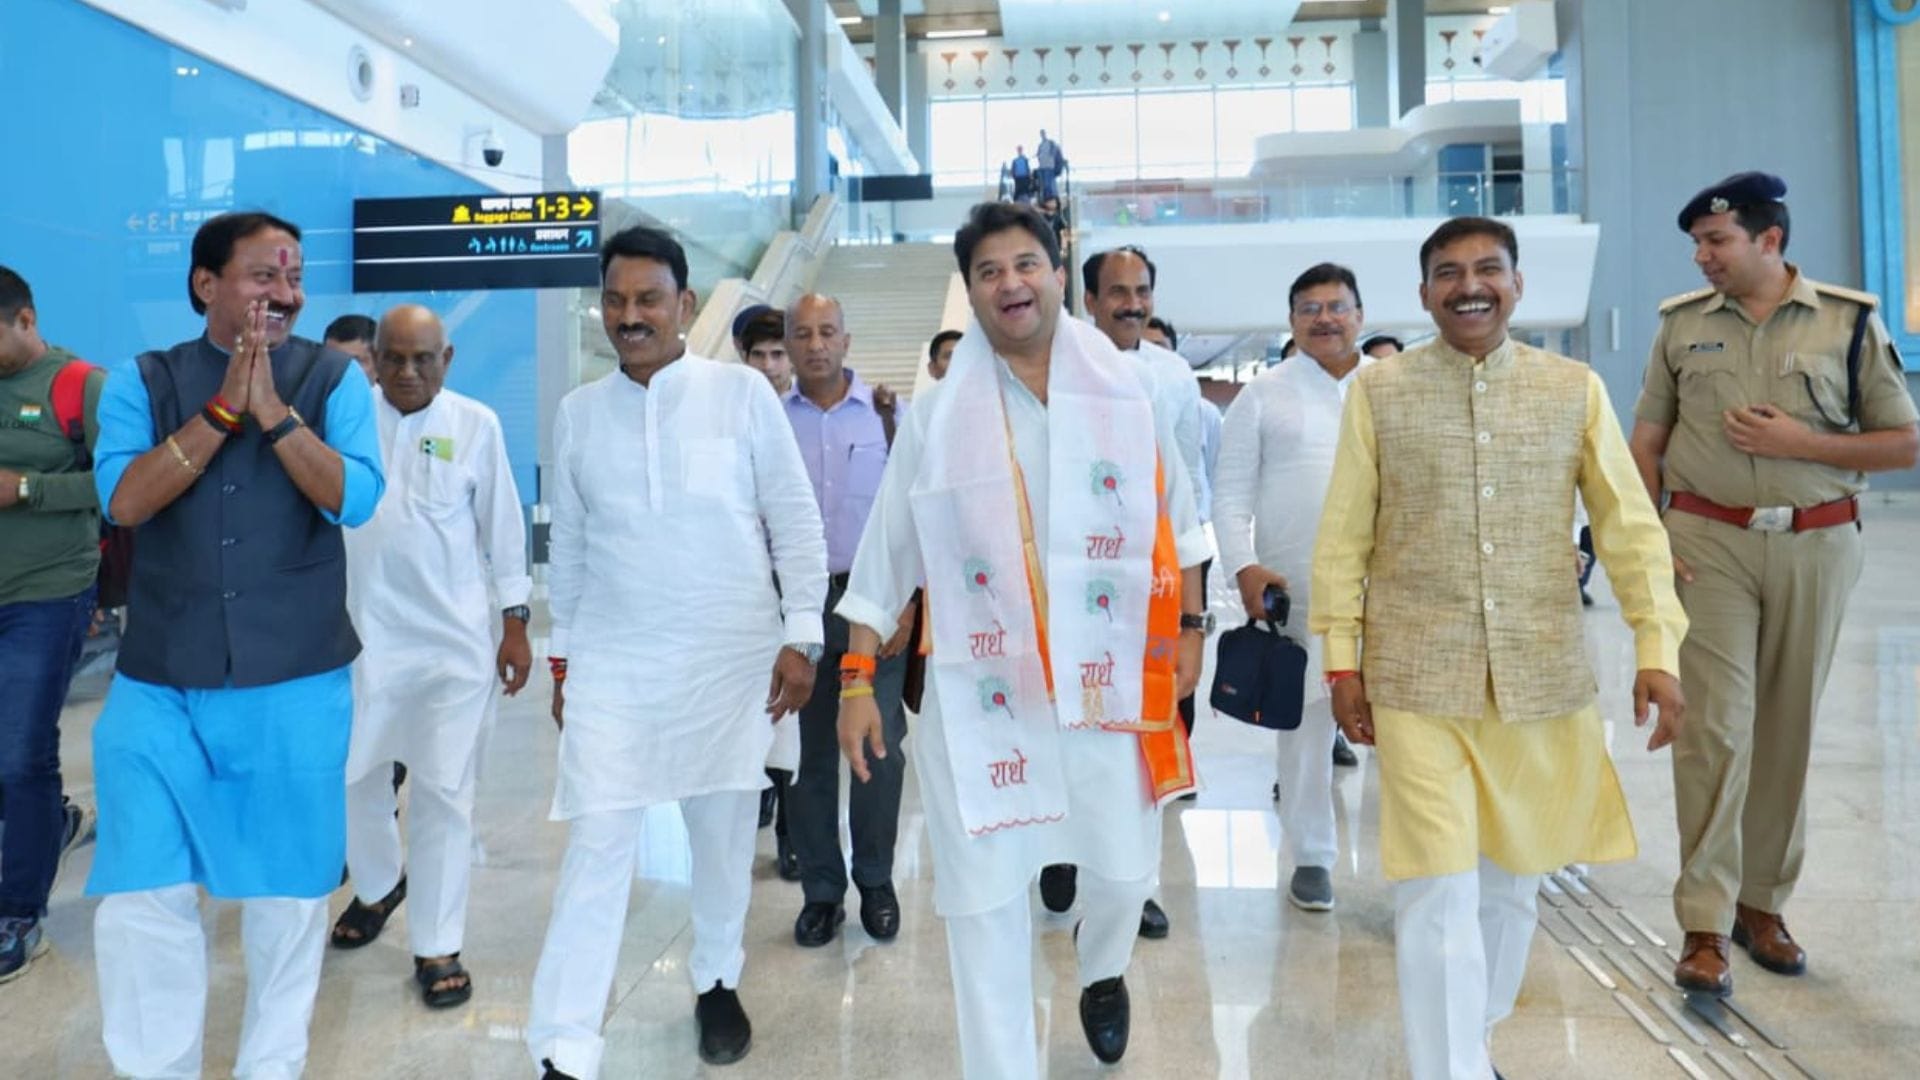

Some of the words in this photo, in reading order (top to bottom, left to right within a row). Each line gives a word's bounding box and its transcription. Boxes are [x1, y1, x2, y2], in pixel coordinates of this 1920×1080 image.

[536, 196, 570, 221] 1-3
[1085, 525, 1126, 560] राधे
[968, 619, 1007, 660] राधे
[1079, 651, 1115, 688] राधे
[988, 748, 1028, 789] राधे
